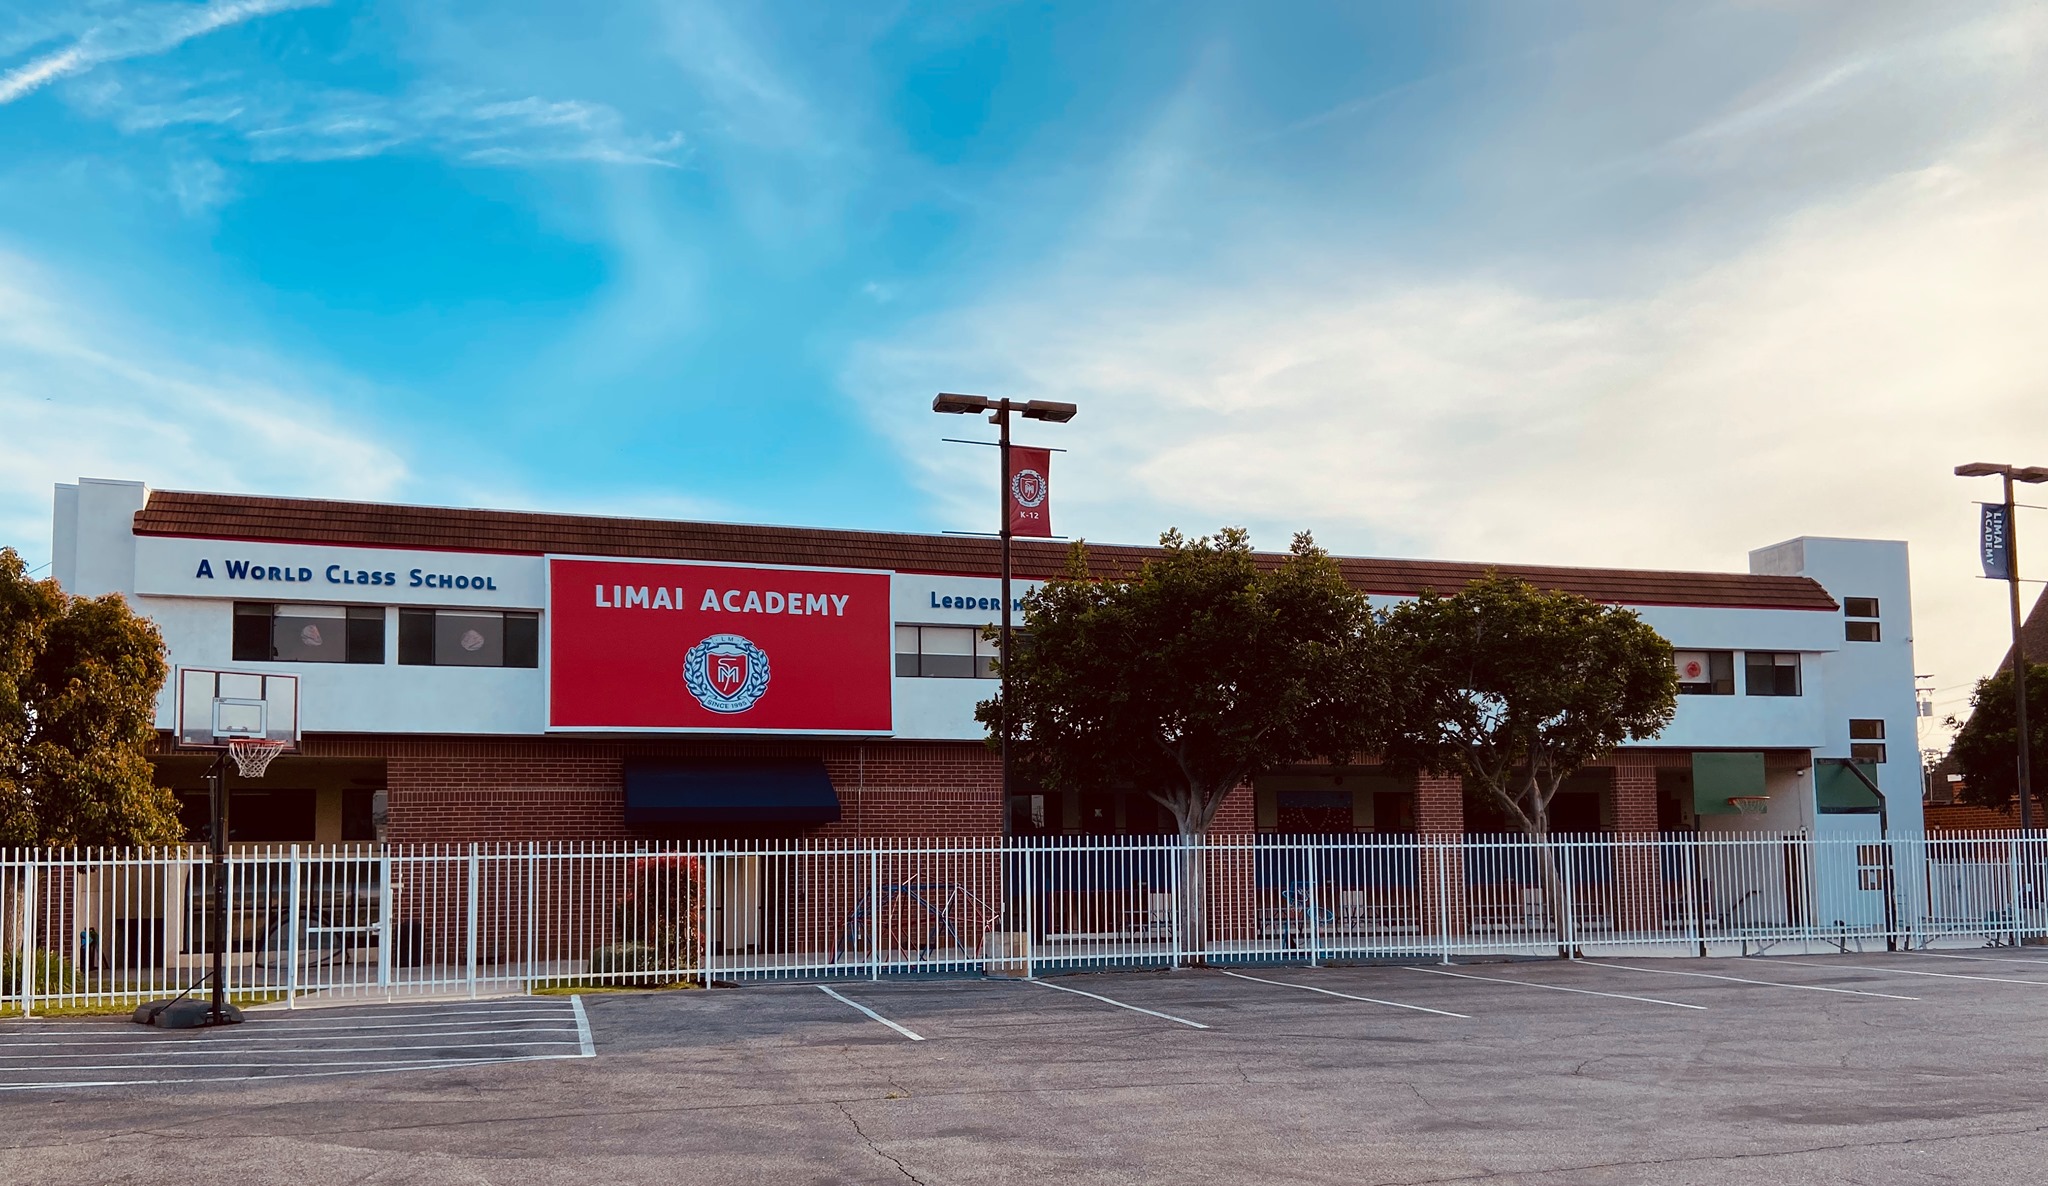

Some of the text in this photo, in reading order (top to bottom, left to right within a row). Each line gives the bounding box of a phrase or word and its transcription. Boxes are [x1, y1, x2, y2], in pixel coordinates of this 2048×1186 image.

[1020, 511, 1039, 520] K-12
[1985, 511, 1994, 565] ACADEMY
[1993, 512, 2003, 549] LIMAI
[196, 558, 214, 580] A
[595, 584, 850, 617] LIMAI ACADEMY
[706, 700, 748, 709] SINCE 1995
